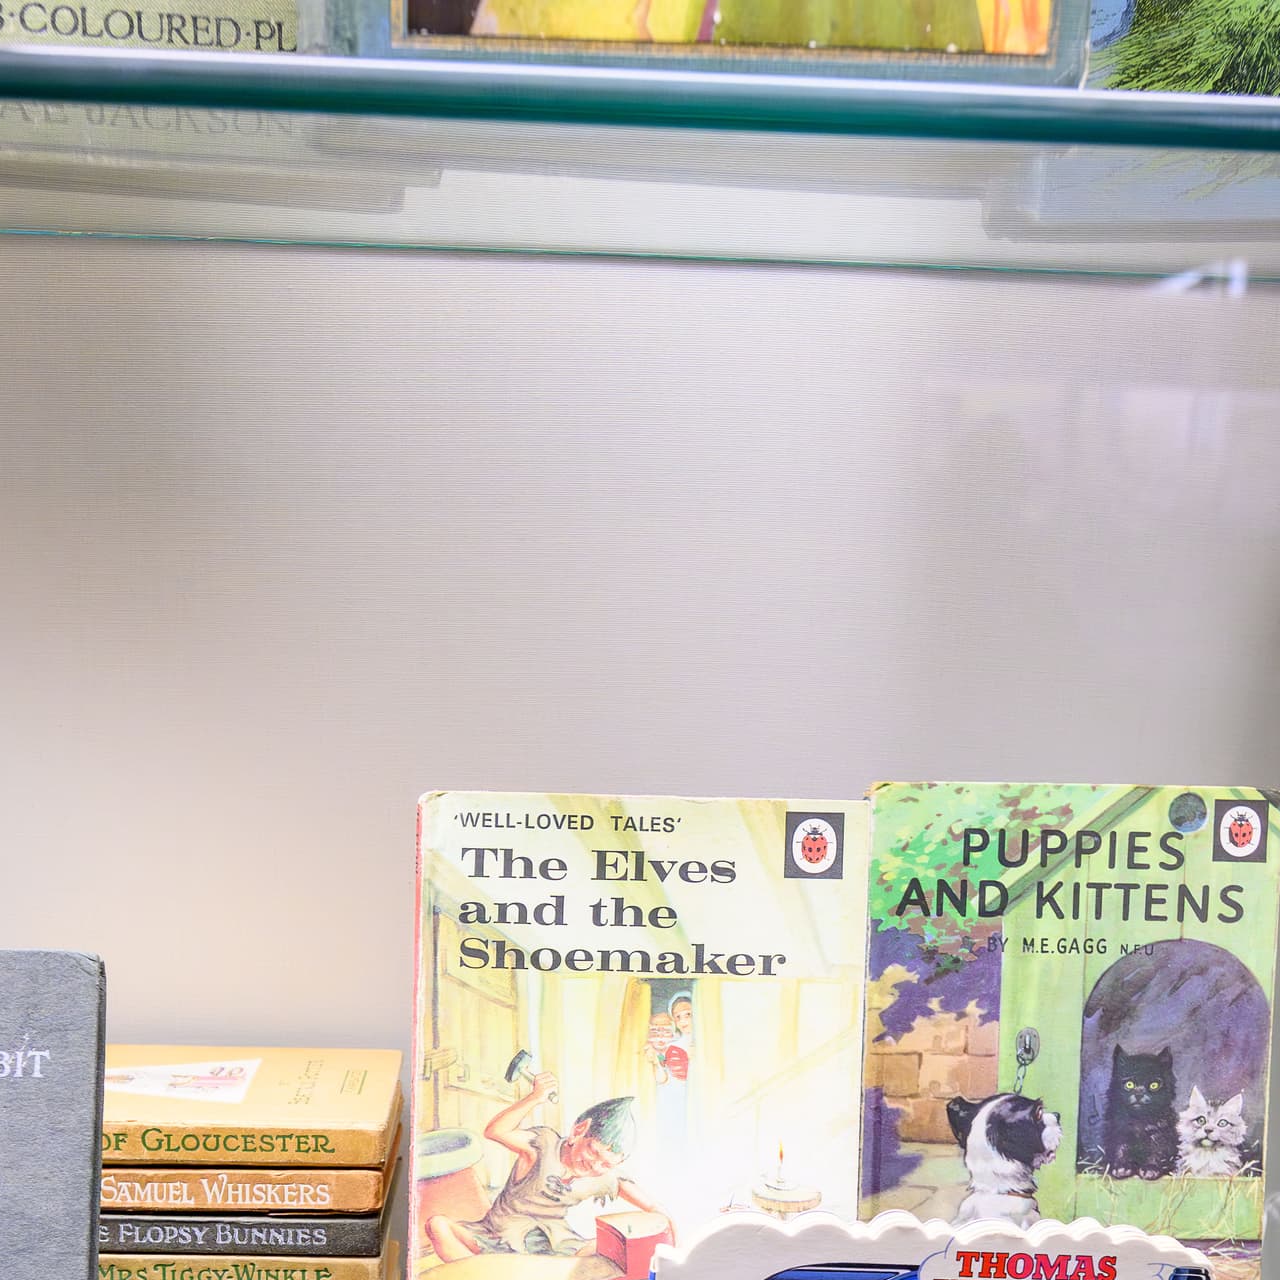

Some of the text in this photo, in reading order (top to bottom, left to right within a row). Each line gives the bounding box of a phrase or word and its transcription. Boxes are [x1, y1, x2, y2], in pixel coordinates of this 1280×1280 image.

[461, 847, 737, 884] The Elves
[962, 828, 1185, 871] PUPPIES
[459, 895, 678, 928] and the
[895, 877, 1245, 924] AND KITTENS
[459, 937, 787, 976] Shoemaker
[987, 936, 1009, 954] BY
[141, 1128, 335, 1153] GLOUCESTER
[100, 1175, 330, 1205] SAMUEL WHISKERS
[119, 1224, 327, 1245] FLOPSY BUNNIES
